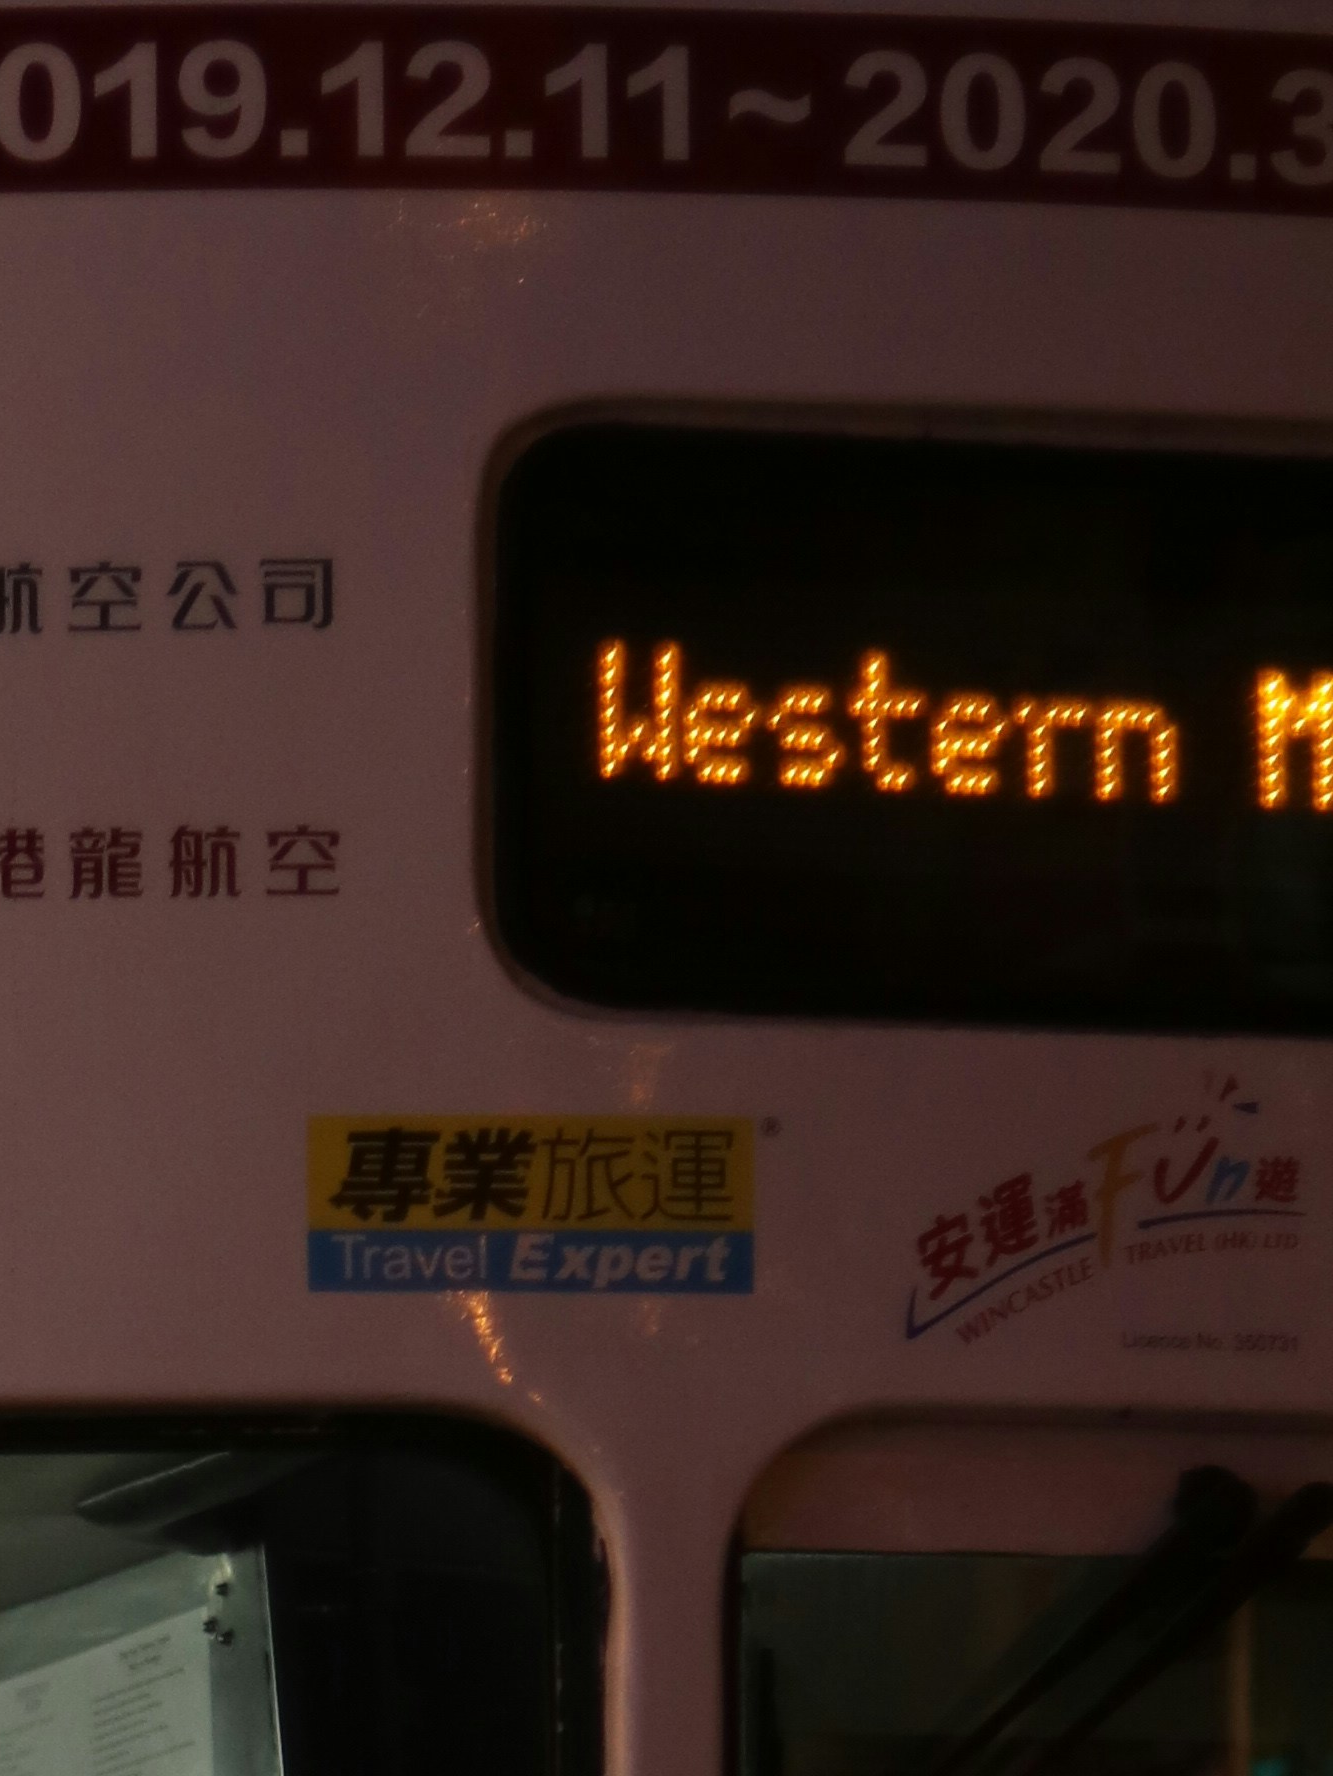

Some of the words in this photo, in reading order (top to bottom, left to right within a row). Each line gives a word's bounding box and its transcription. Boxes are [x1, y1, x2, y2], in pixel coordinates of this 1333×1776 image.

[595, 635, 1181, 804] Western
[329, 1126, 734, 1223] 專業旅運
[331, 1233, 489, 1283] Travel
[508, 1234, 732, 1289] Expert
[954, 1256, 1095, 1346] WINCASTLE
[1123, 1231, 1206, 1266] TRAVEL
